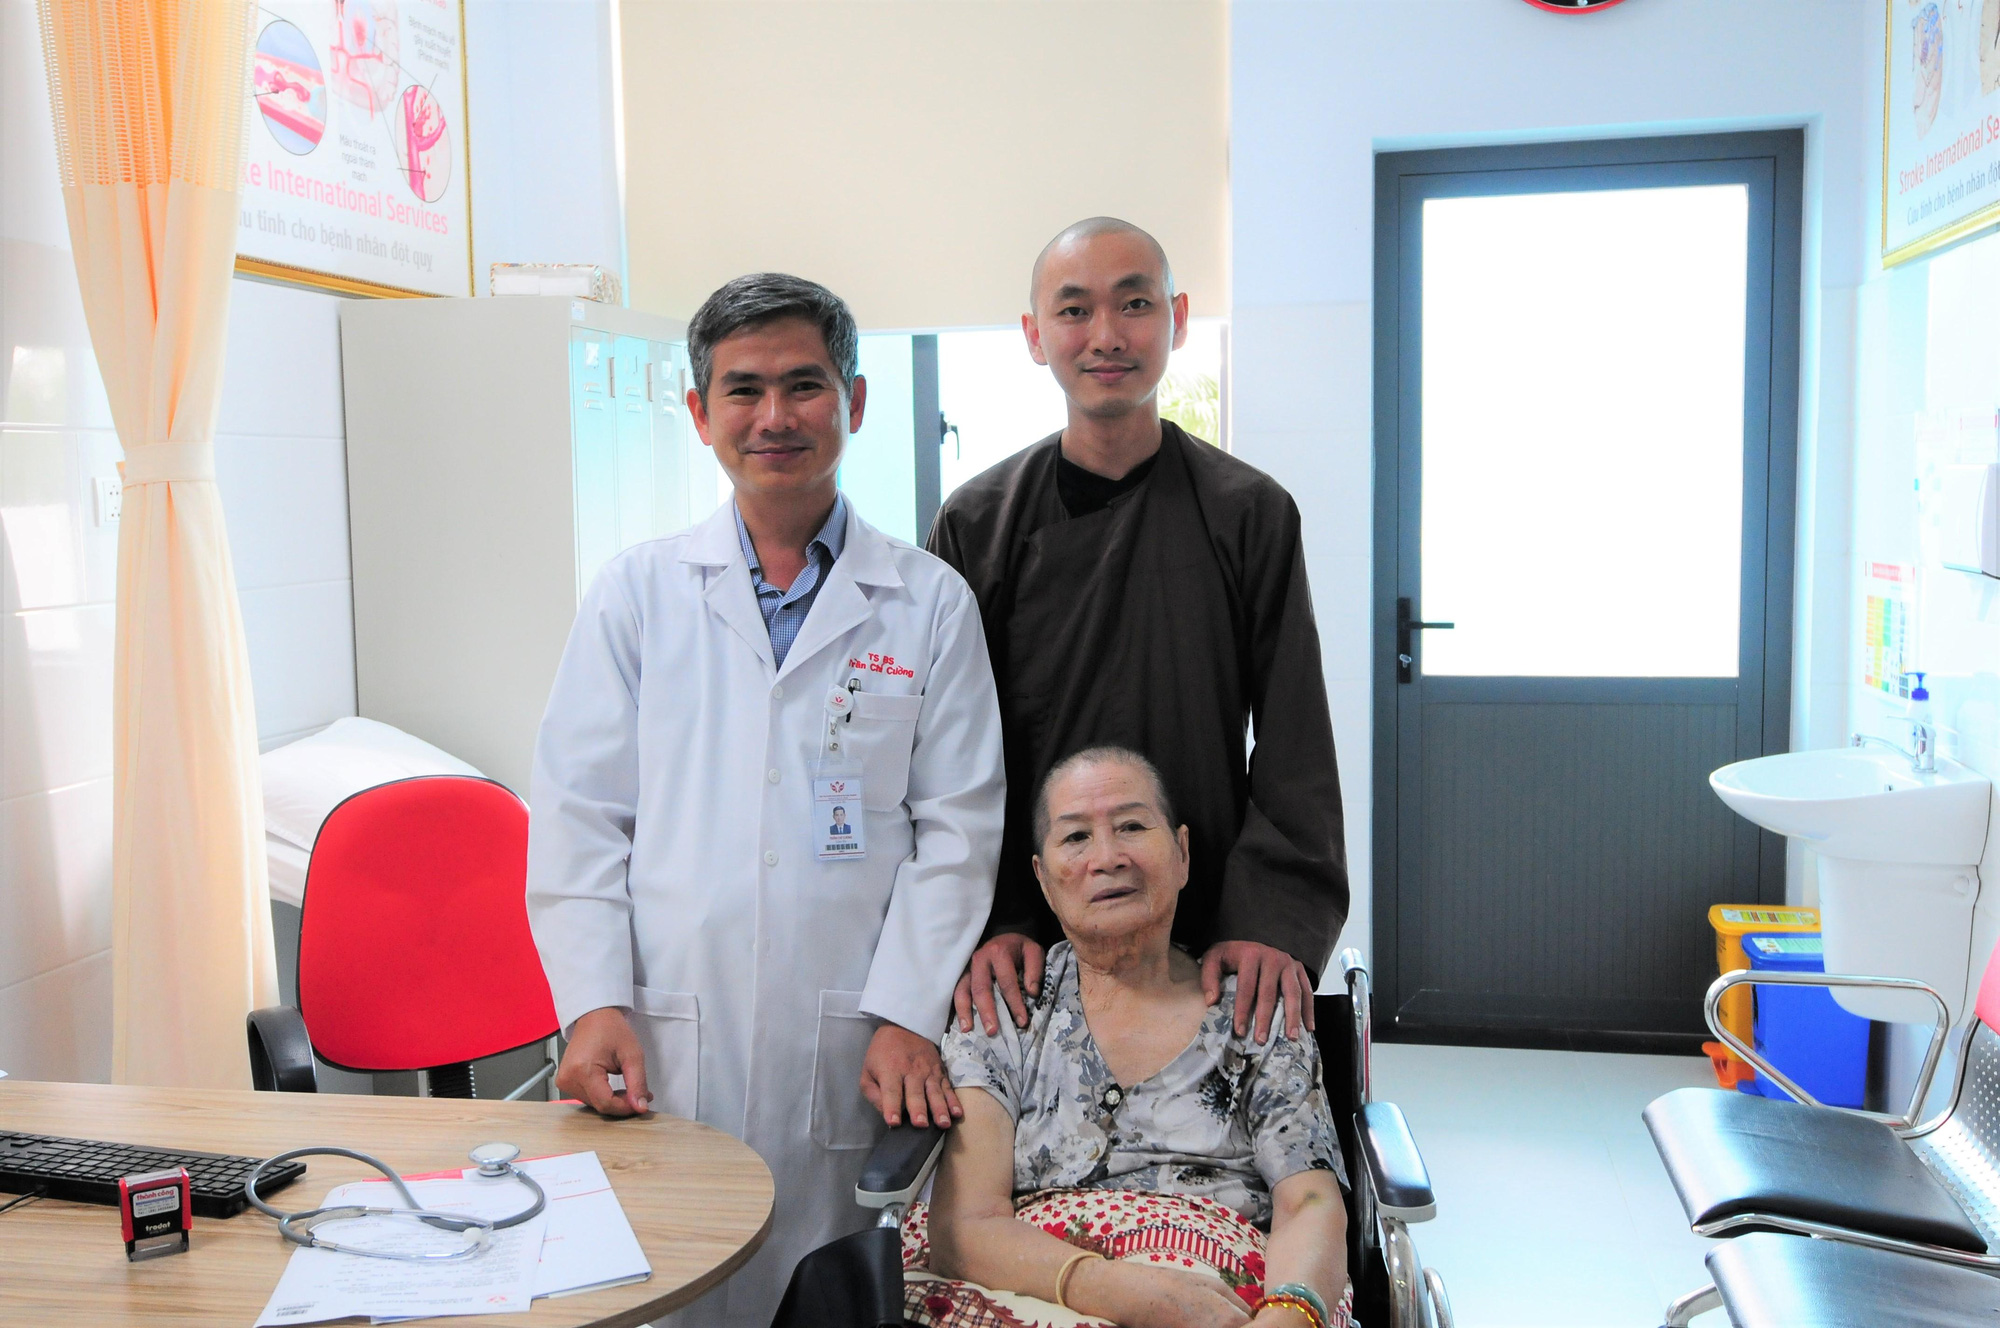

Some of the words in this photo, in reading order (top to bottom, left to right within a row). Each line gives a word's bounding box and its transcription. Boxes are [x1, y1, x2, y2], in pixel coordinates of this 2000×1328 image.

[1899, 161, 1925, 195] Stroke
[1926, 119, 1983, 179] International
[268, 160, 382, 218] International
[386, 194, 449, 235] Services
[1934, 191, 1946, 212] cho
[291, 217, 316, 242] cho
[320, 223, 353, 252] bệnh
[356, 232, 387, 258] nhân
[391, 238, 411, 267] đột
[868, 652, 880, 662] TS
[883, 655, 894, 666] BS
[886, 665, 914, 678] Cường
[145, 1222, 170, 1231] trodat
